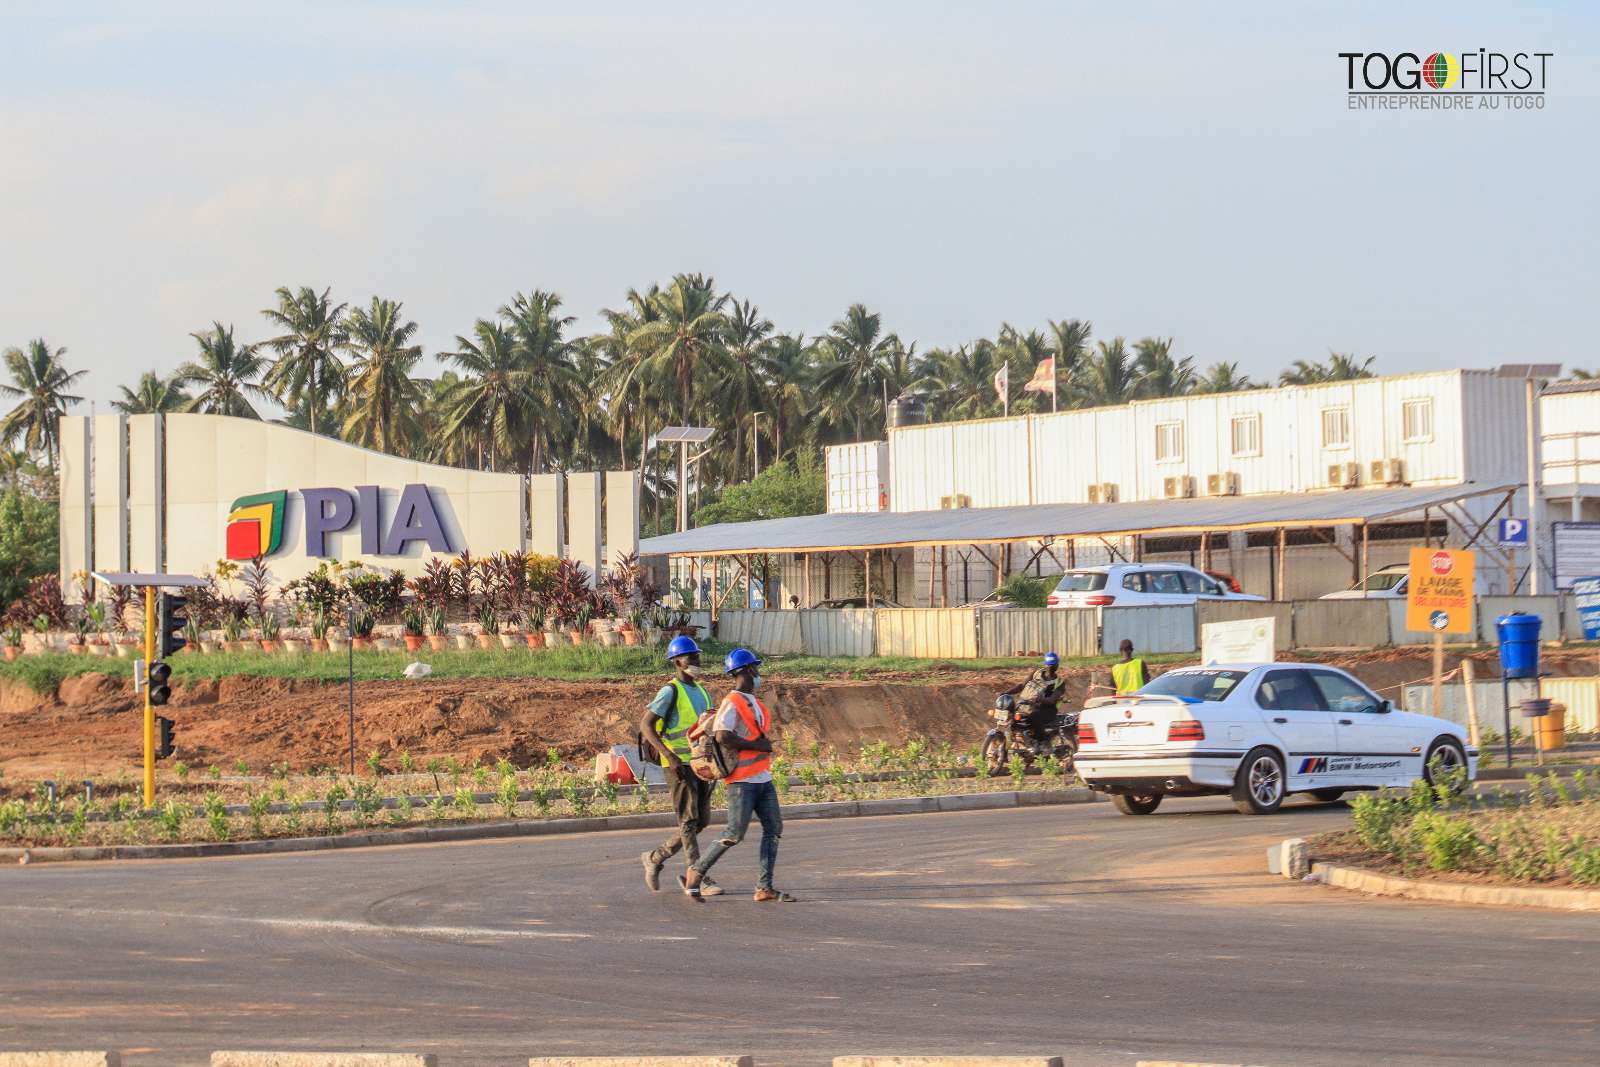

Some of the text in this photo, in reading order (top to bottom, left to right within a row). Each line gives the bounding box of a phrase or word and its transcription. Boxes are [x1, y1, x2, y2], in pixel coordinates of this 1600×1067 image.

[299, 484, 452, 556] PIA
[1505, 520, 1522, 540] P
[1432, 557, 1453, 568] STOP
[1419, 576, 1464, 587] LAVAGE
[1330, 760, 1401, 771] BMW Motorsport
